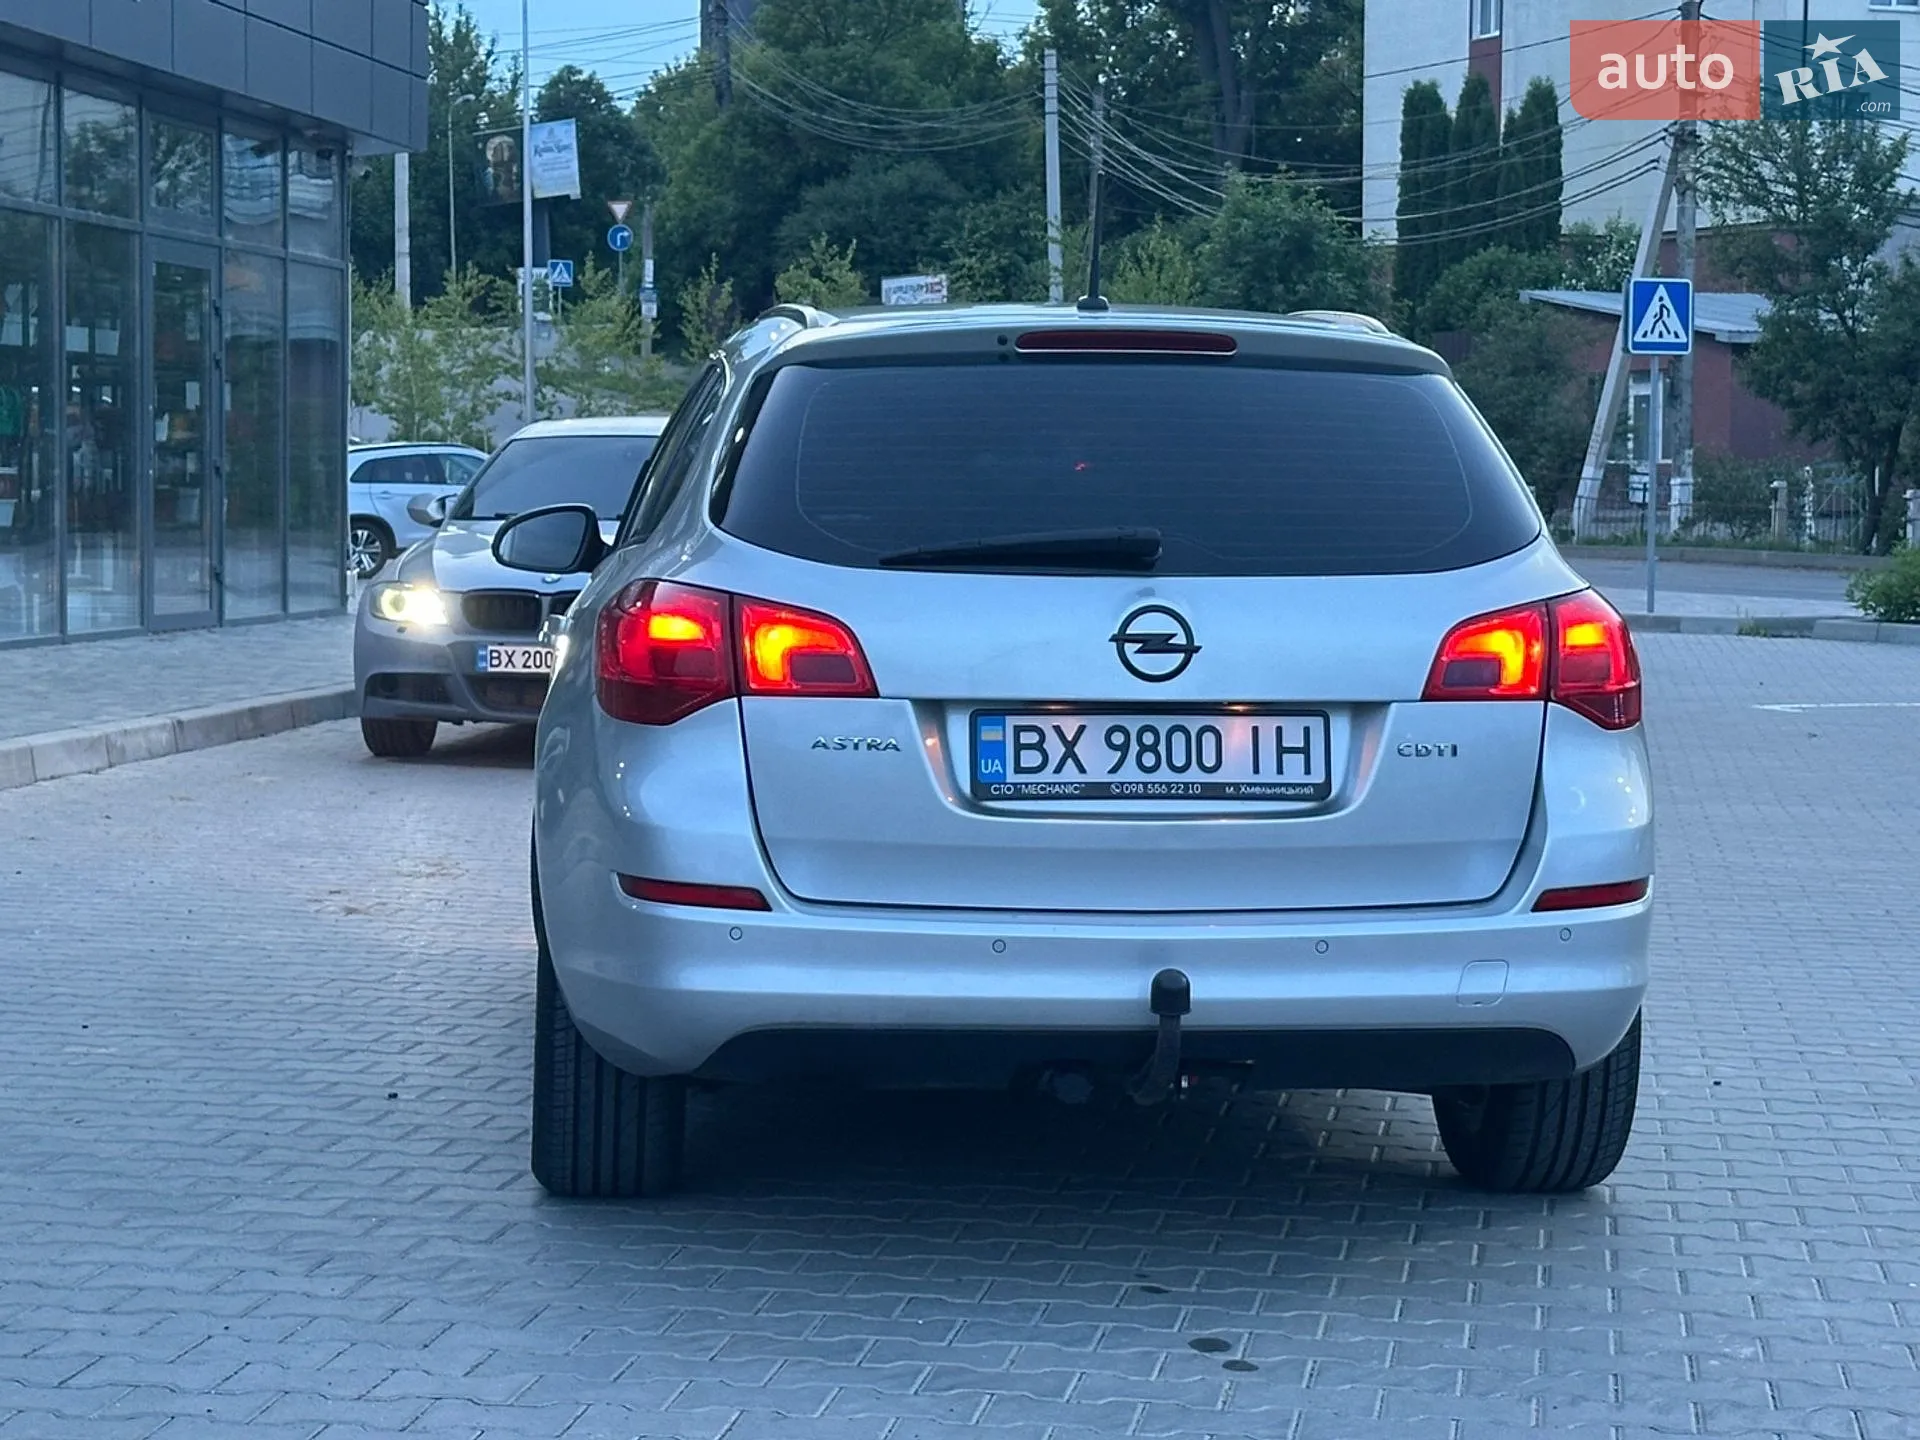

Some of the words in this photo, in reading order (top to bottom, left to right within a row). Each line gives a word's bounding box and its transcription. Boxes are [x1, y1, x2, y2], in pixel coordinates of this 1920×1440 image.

[489, 649, 516, 668] BX
[522, 650, 553, 668] 200
[811, 736, 901, 752] ASTRA
[1012, 725, 1087, 774] BX
[1104, 725, 1223, 774] 9800
[1251, 725, 1312, 775] IH
[1397, 743, 1458, 757] CDTI
[981, 760, 1003, 773] UA
[990, 784, 1014, 795] СТО
[1122, 783, 1144, 794] 098
[1170, 783, 1184, 794] 22
[1188, 783, 1201, 794] 10
